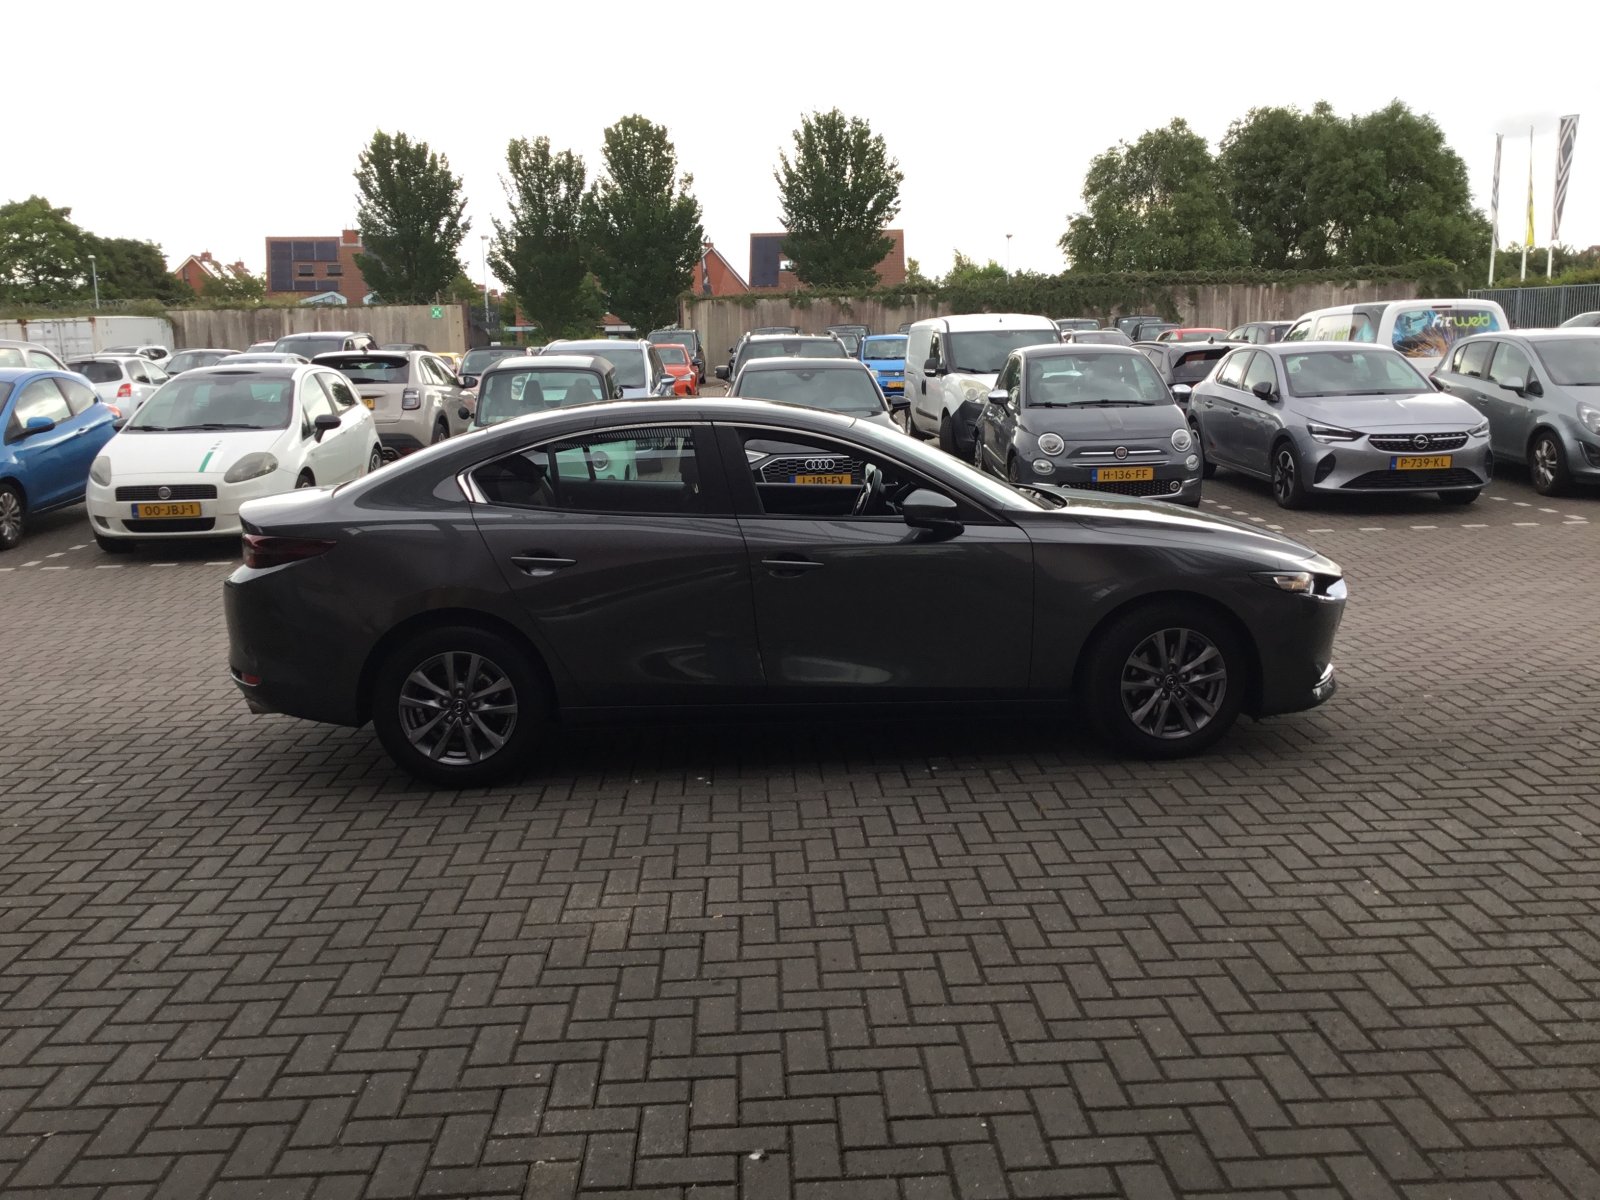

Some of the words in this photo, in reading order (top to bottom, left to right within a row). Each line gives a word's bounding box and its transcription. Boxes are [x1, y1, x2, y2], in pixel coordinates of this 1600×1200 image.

[1401, 457, 1447, 468] P-739-KL
[1103, 469, 1148, 480] H-136-FF
[144, 504, 195, 516] 00-JBJ-1
